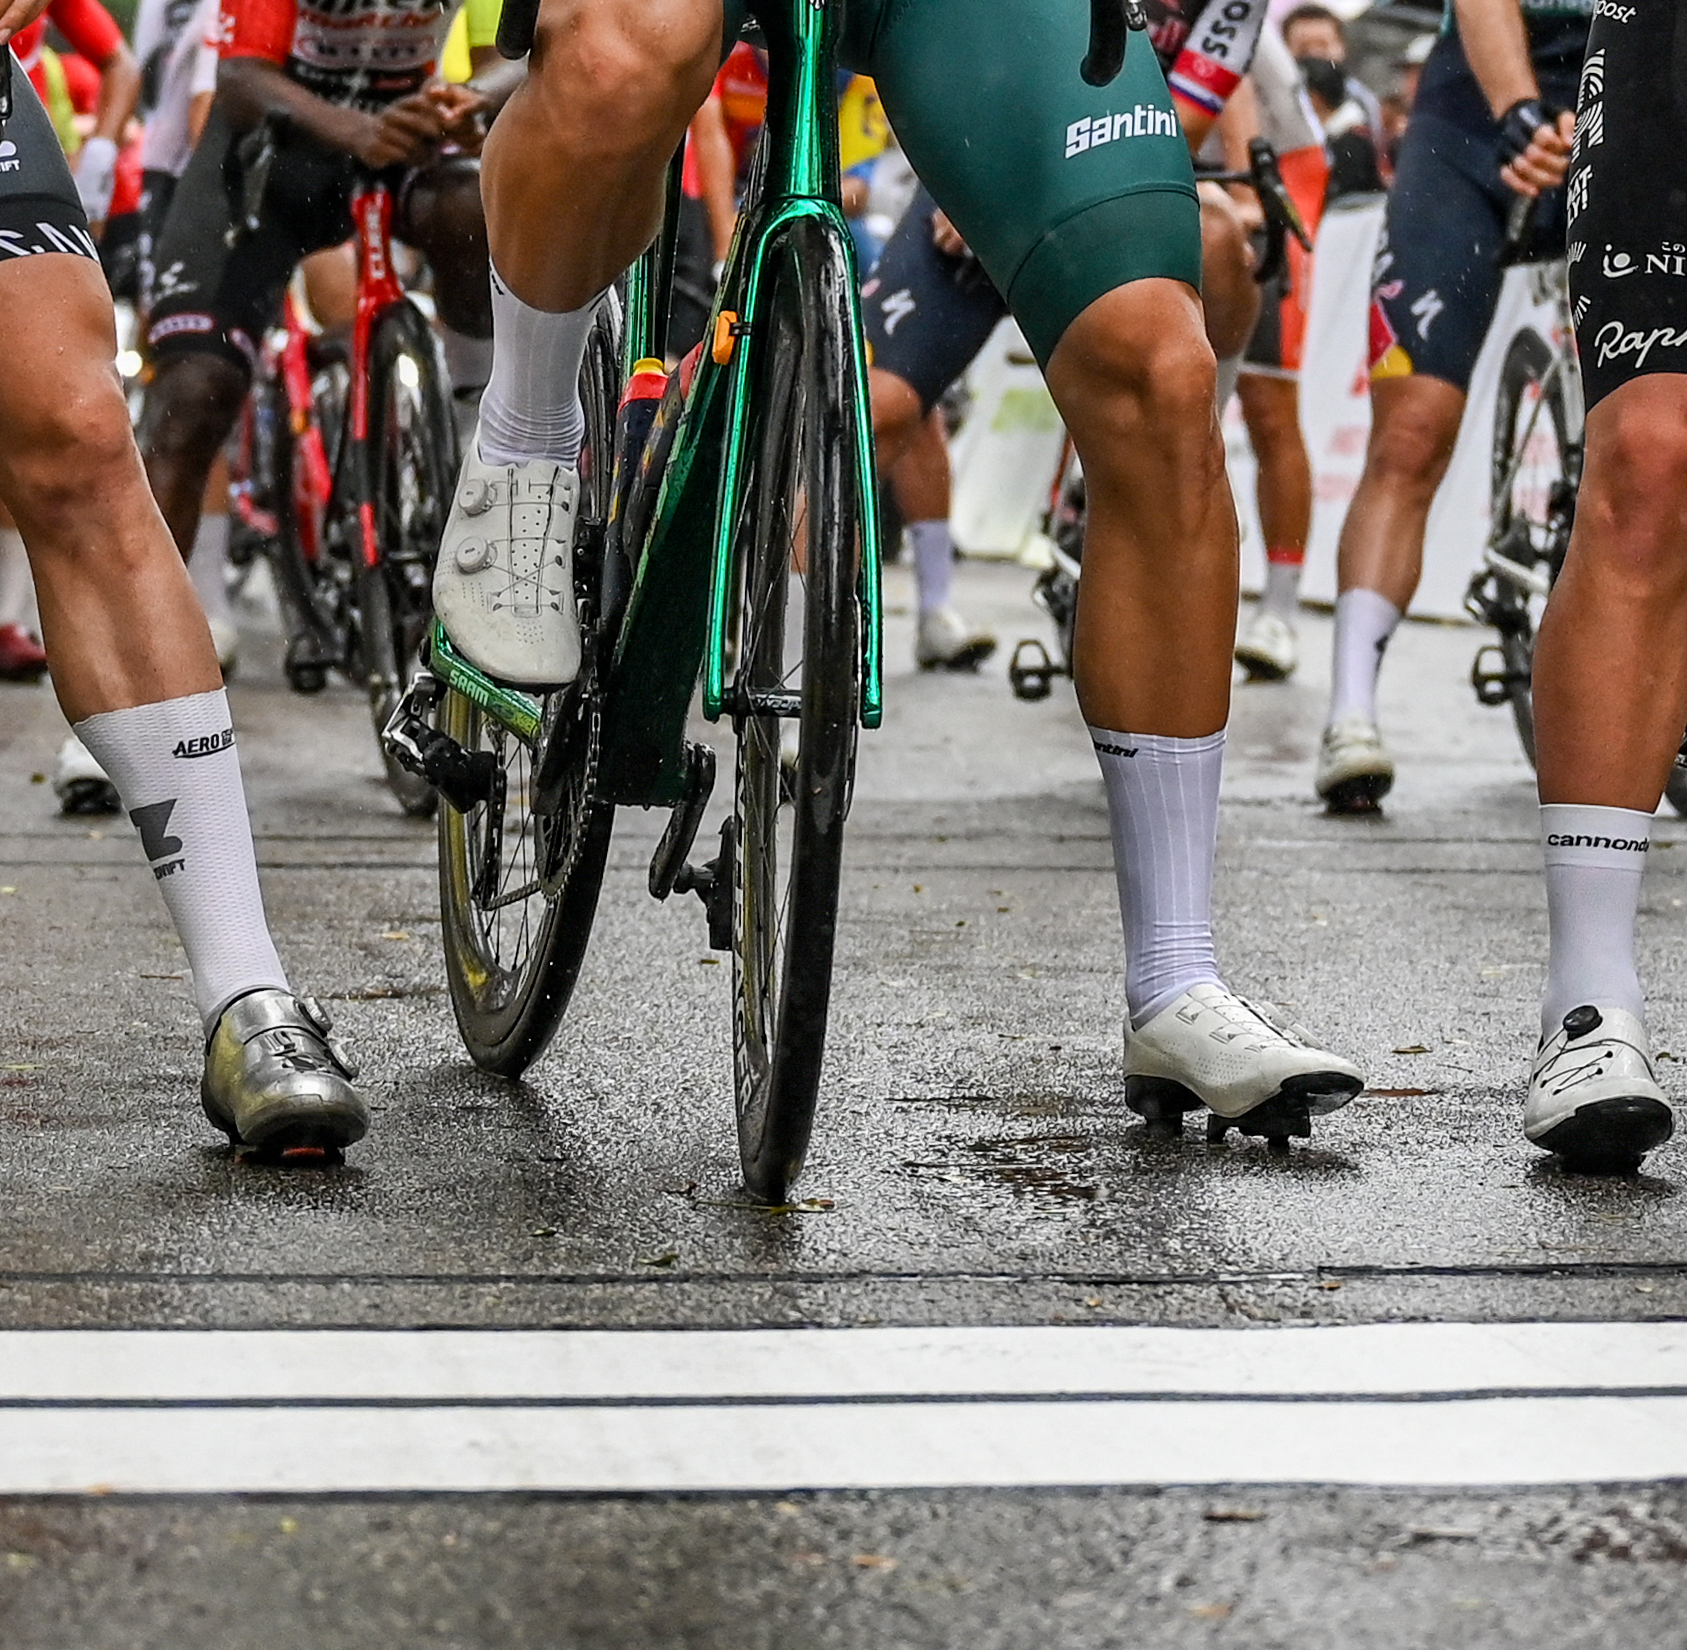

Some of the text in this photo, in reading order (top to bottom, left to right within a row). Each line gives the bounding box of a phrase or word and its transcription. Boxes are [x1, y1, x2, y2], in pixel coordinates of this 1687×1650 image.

[1065, 104, 1178, 159] Santini
[449, 669, 490, 707] SRAM
[172, 733, 220, 756] AERO
